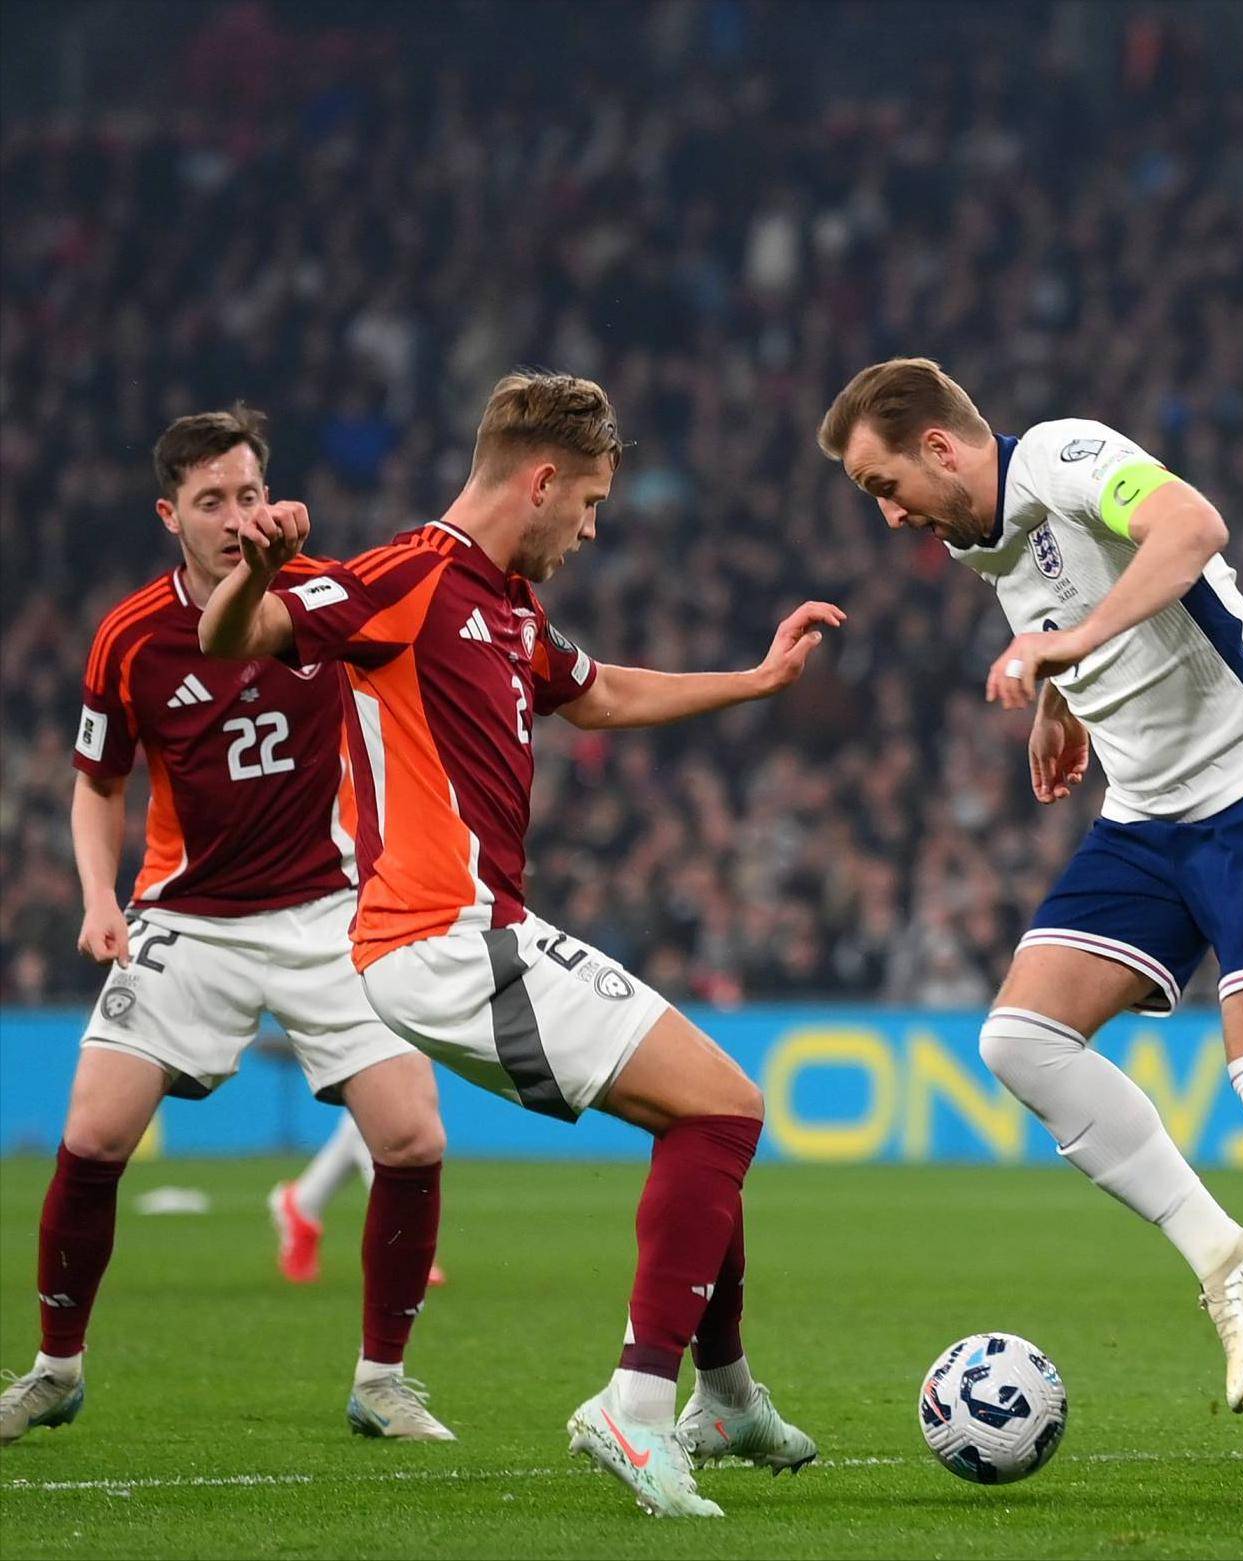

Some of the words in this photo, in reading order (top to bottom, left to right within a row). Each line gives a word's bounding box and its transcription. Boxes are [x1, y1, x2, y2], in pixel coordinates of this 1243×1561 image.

[1113, 480, 1141, 506] C
[511, 675, 529, 744] 2
[222, 711, 295, 781] 22
[536, 933, 588, 971] 2
